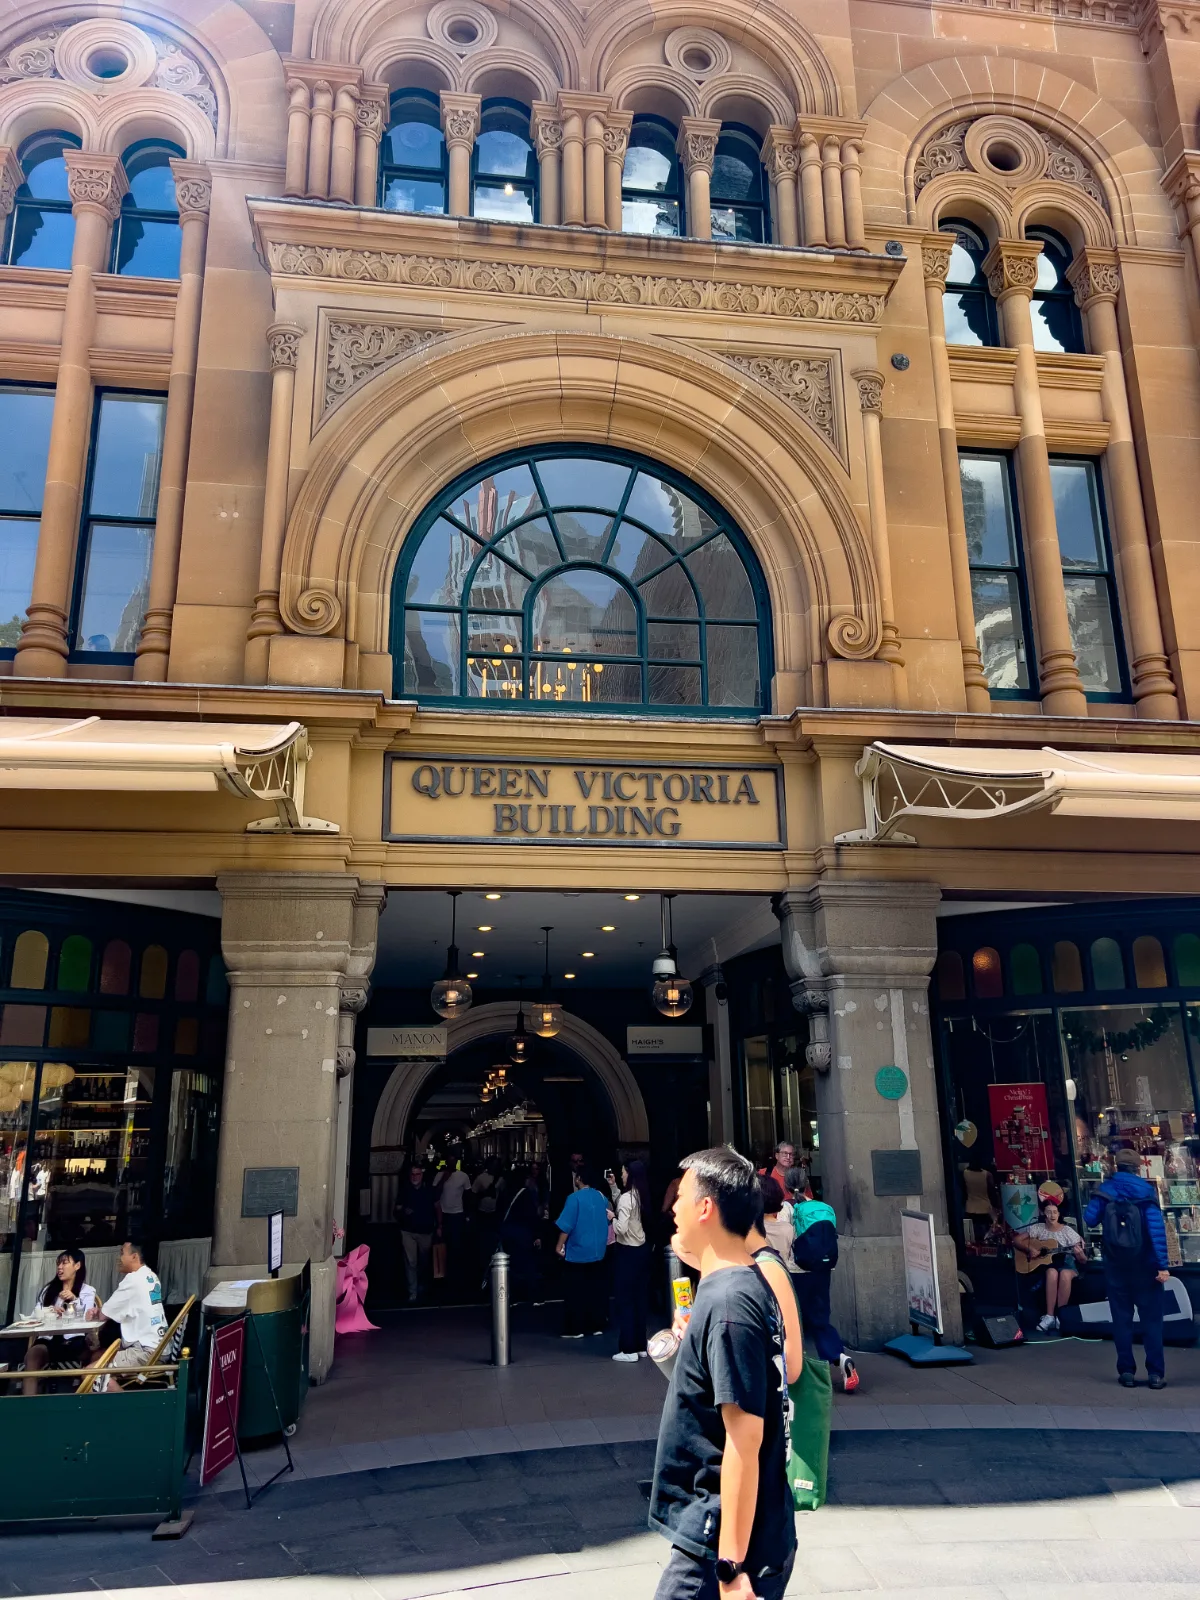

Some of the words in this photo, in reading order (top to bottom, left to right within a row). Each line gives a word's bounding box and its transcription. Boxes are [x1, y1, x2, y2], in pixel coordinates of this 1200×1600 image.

[411, 765, 551, 799] QUEEN
[574, 770, 760, 804] VICTORIA
[493, 803, 682, 836] BUILDING
[391, 1033, 442, 1045] MANON
